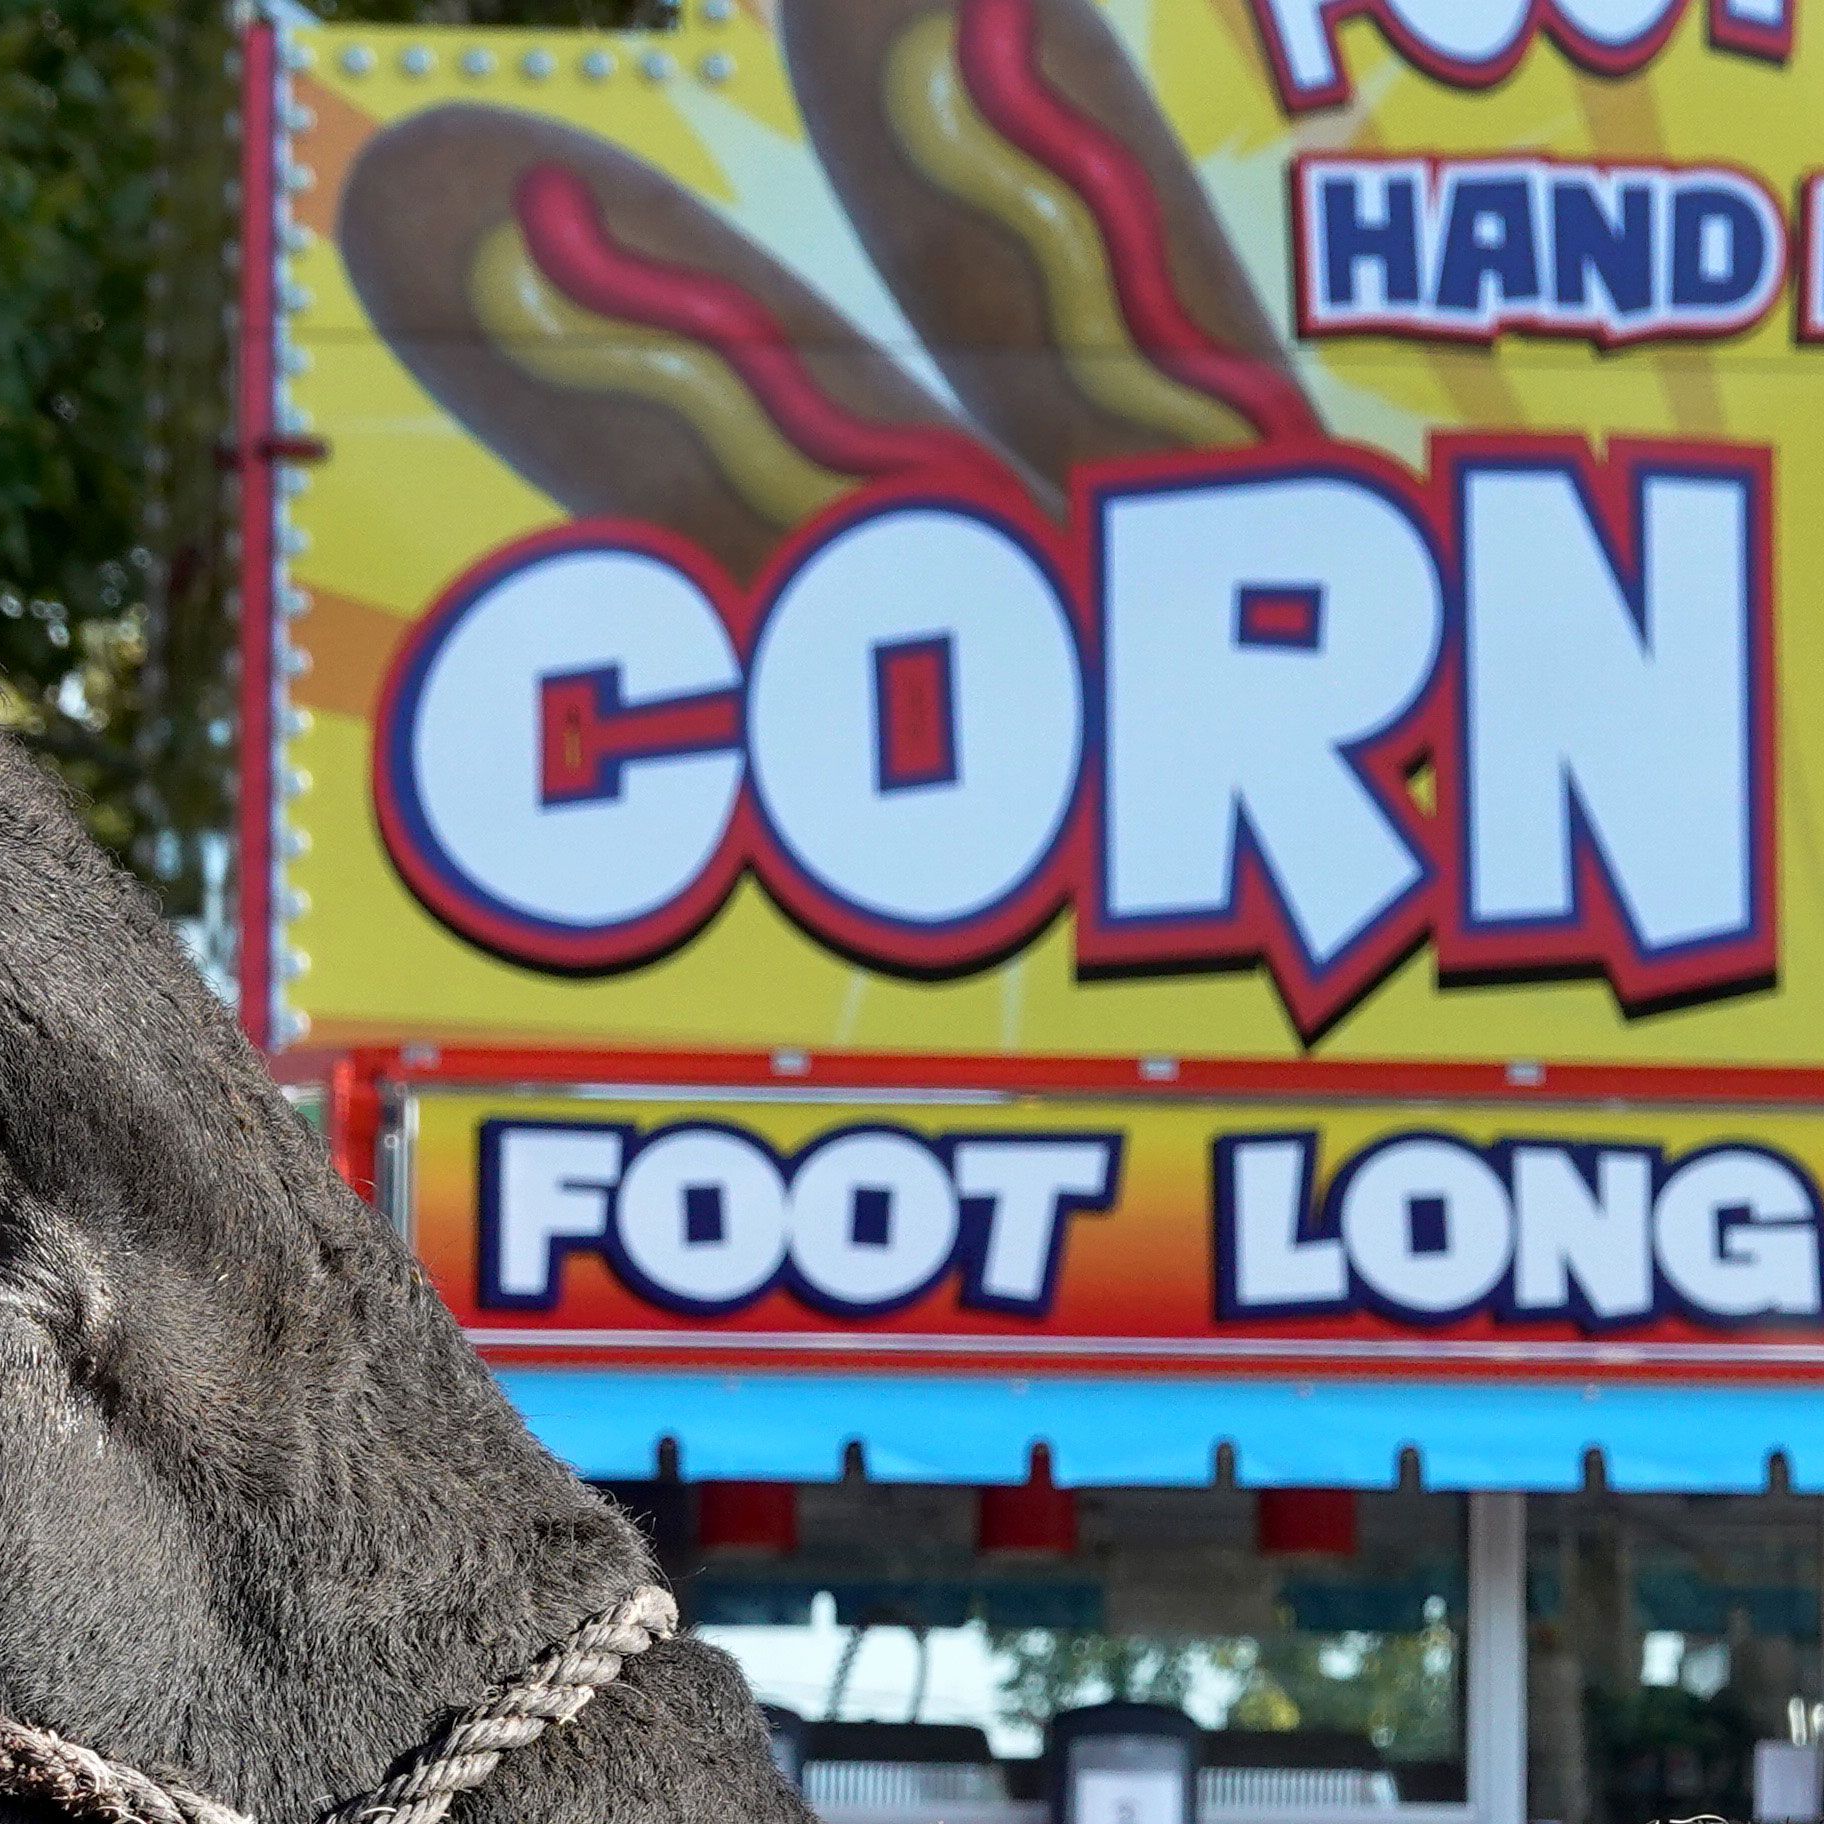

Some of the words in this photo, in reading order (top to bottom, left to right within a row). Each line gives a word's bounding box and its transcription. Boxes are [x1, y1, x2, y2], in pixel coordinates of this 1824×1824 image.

[1312, 166, 1776, 326] HAND
[398, 452, 1761, 985] CORN
[488, 1122, 1116, 1312] FOOT
